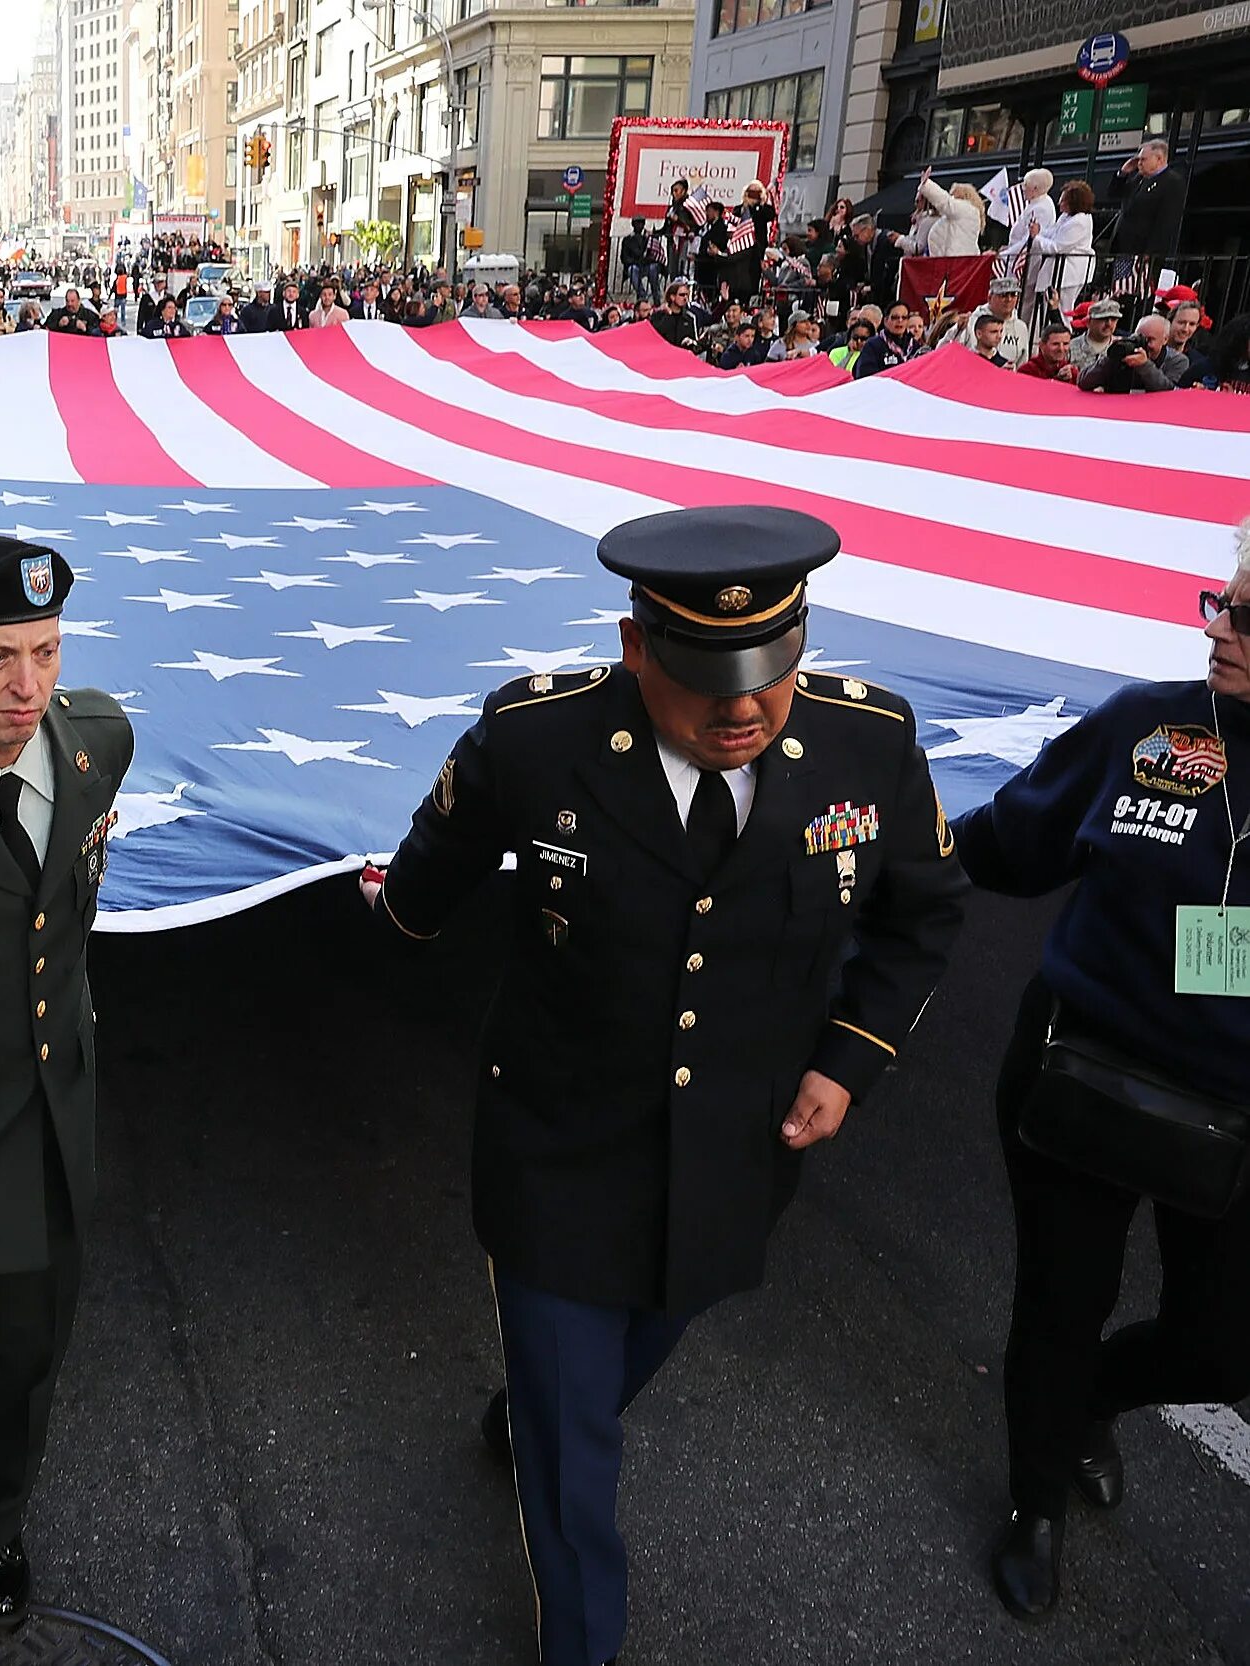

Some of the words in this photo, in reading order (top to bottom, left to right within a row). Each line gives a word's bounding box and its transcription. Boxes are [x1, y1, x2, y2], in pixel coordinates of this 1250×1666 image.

[1203, 5, 1250, 30] OPENI
[659, 160, 737, 179] Freedom
[1003, 335, 1019, 346] MY
[1113, 795, 1198, 831] 9-11-01
[1111, 820, 1143, 836] Never
[1142, 823, 1185, 846] Forget
[540, 850, 576, 869] JIMENEZ
